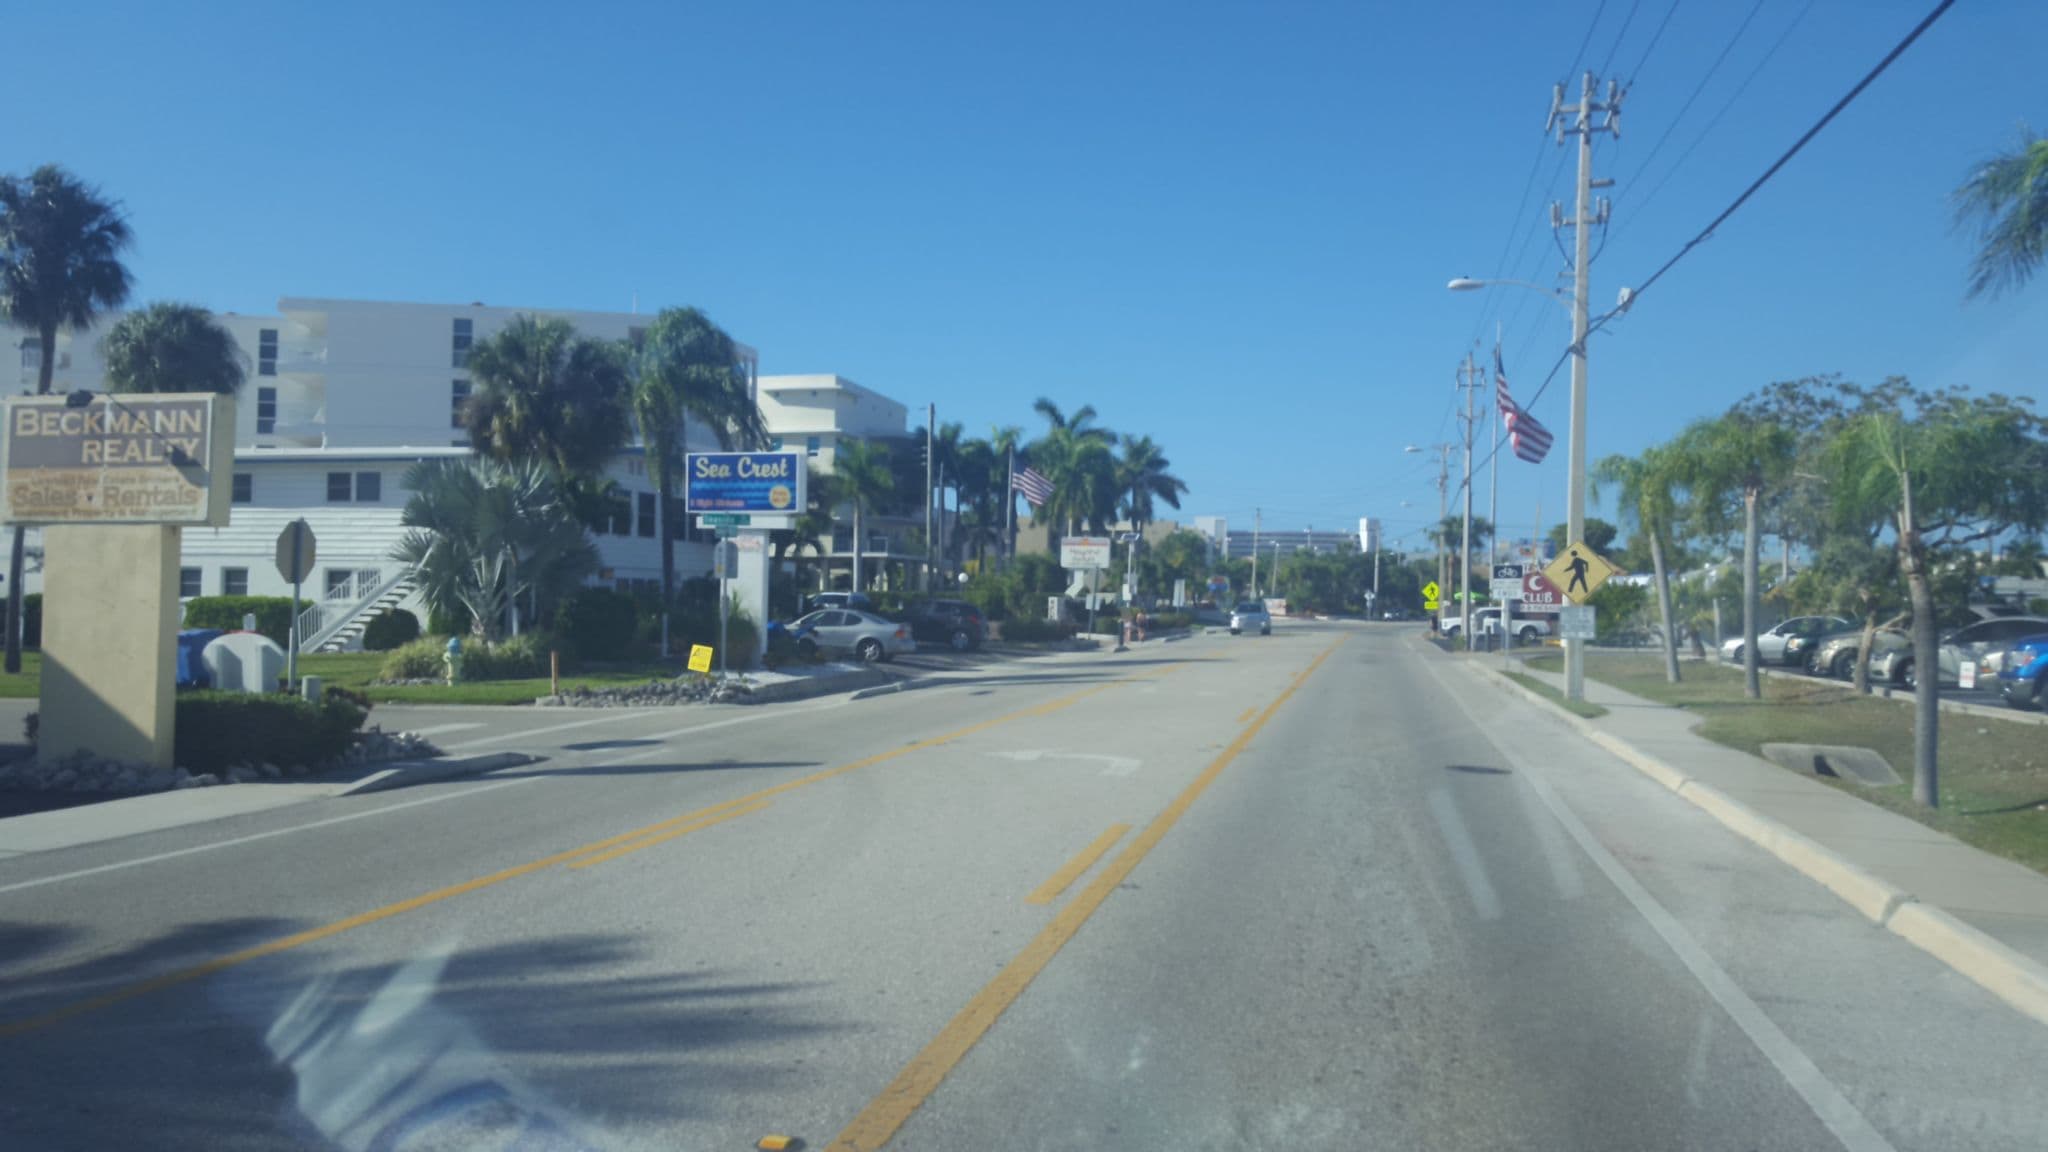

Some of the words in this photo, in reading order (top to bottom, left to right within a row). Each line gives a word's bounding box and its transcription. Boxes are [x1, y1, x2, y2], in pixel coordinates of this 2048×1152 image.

[695, 456, 731, 478] Sea
[737, 456, 789, 478] Crest
[14, 485, 78, 507] Sales
[102, 485, 199, 507] Rentals
[1522, 591, 1552, 603] CLUB
